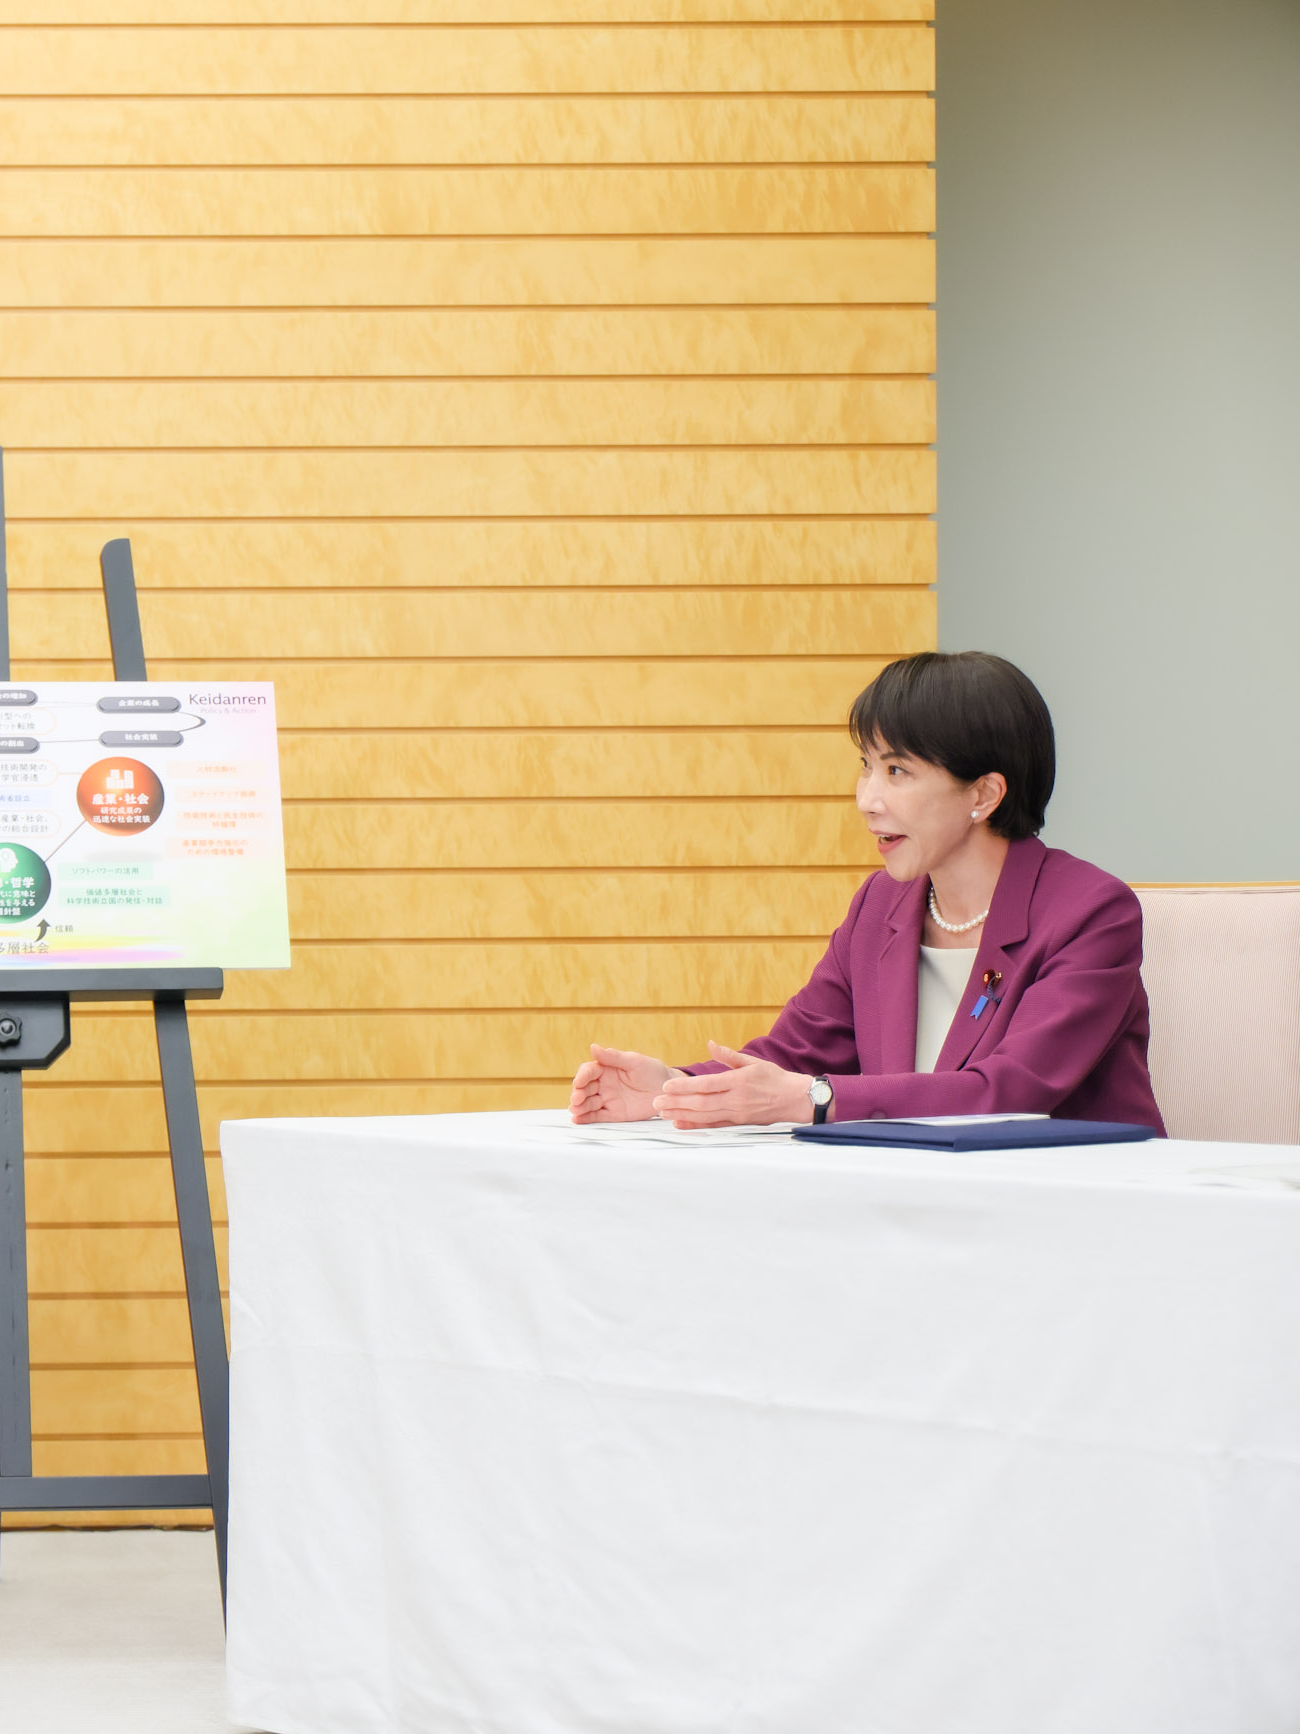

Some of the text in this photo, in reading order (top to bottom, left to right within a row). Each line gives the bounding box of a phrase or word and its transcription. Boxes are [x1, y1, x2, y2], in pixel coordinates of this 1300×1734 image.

[189, 693, 267, 706] Keidanren
[92, 793, 149, 805] 産業・社会
[92, 815, 151, 824] 迅速な社会実装
[71, 867, 140, 875] ソフトパワーの活用
[86, 888, 144, 896] 価値多層社会と
[66, 897, 163, 905] 科学技術立国の発信・対話
[55, 924, 74, 933] 信頼
